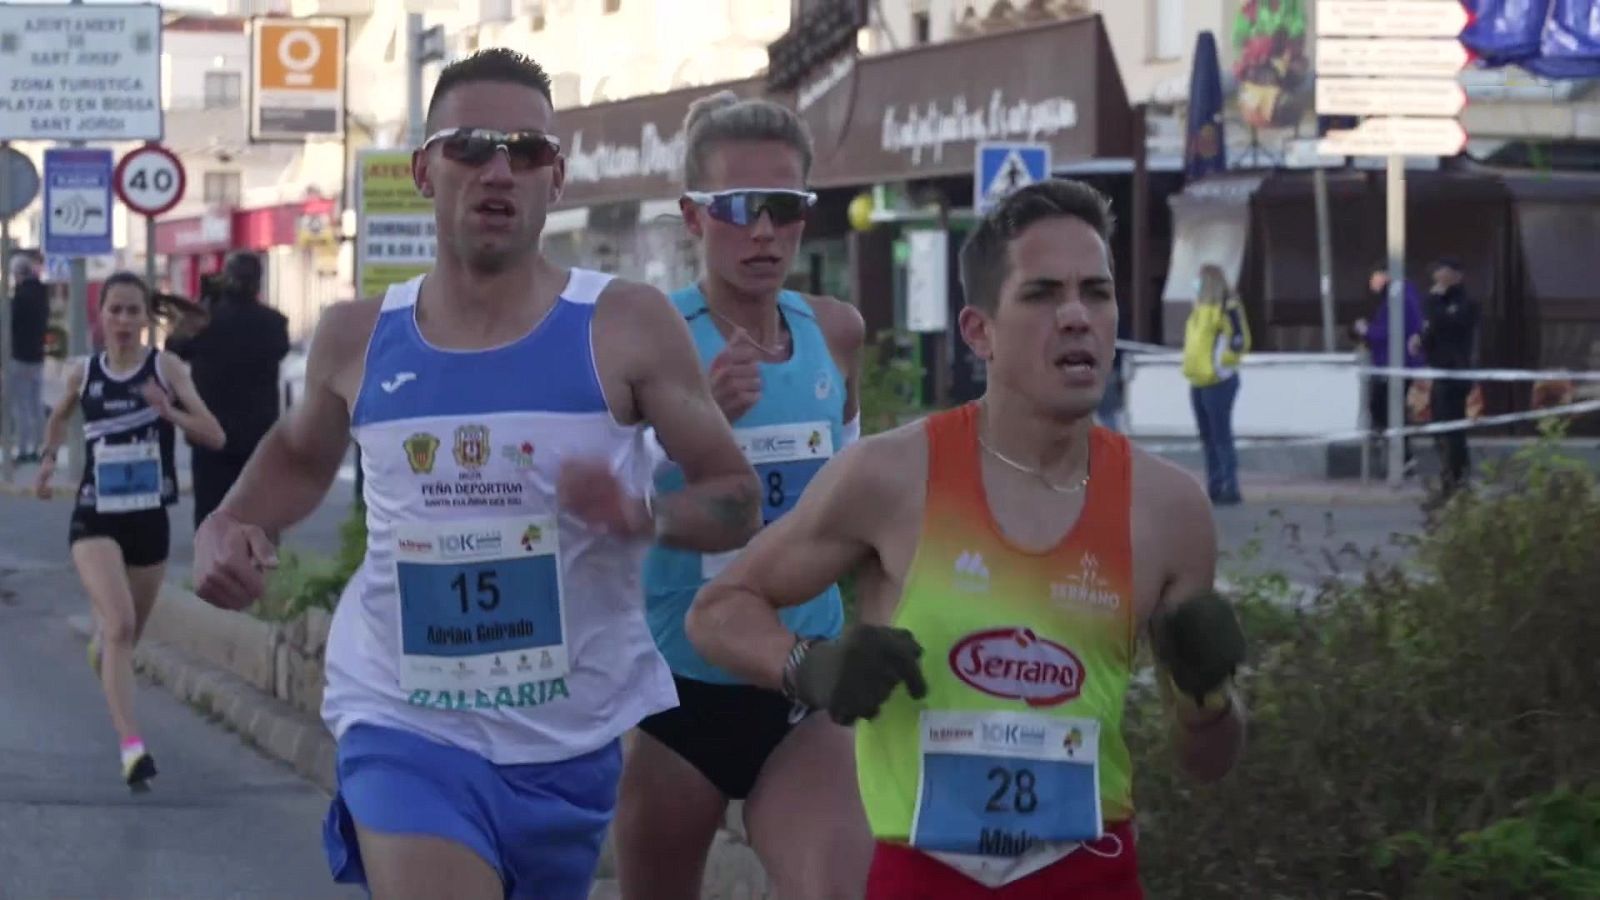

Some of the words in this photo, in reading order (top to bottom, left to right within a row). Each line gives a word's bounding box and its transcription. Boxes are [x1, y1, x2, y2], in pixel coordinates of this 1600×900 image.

[11, 77, 54, 91] ZONA
[102, 97, 153, 111] BOSSA
[30, 117, 71, 130] SANT
[77, 117, 125, 130] JORDI
[128, 168, 173, 193] 40
[422, 482, 452, 495] PEÑA
[455, 482, 523, 495] DEPORTIVA
[768, 471, 784, 507] 8
[451, 570, 500, 614] 15
[1051, 582, 1120, 609] SERRANO
[963, 642, 1074, 688] Serrano
[985, 765, 1038, 813] 28
